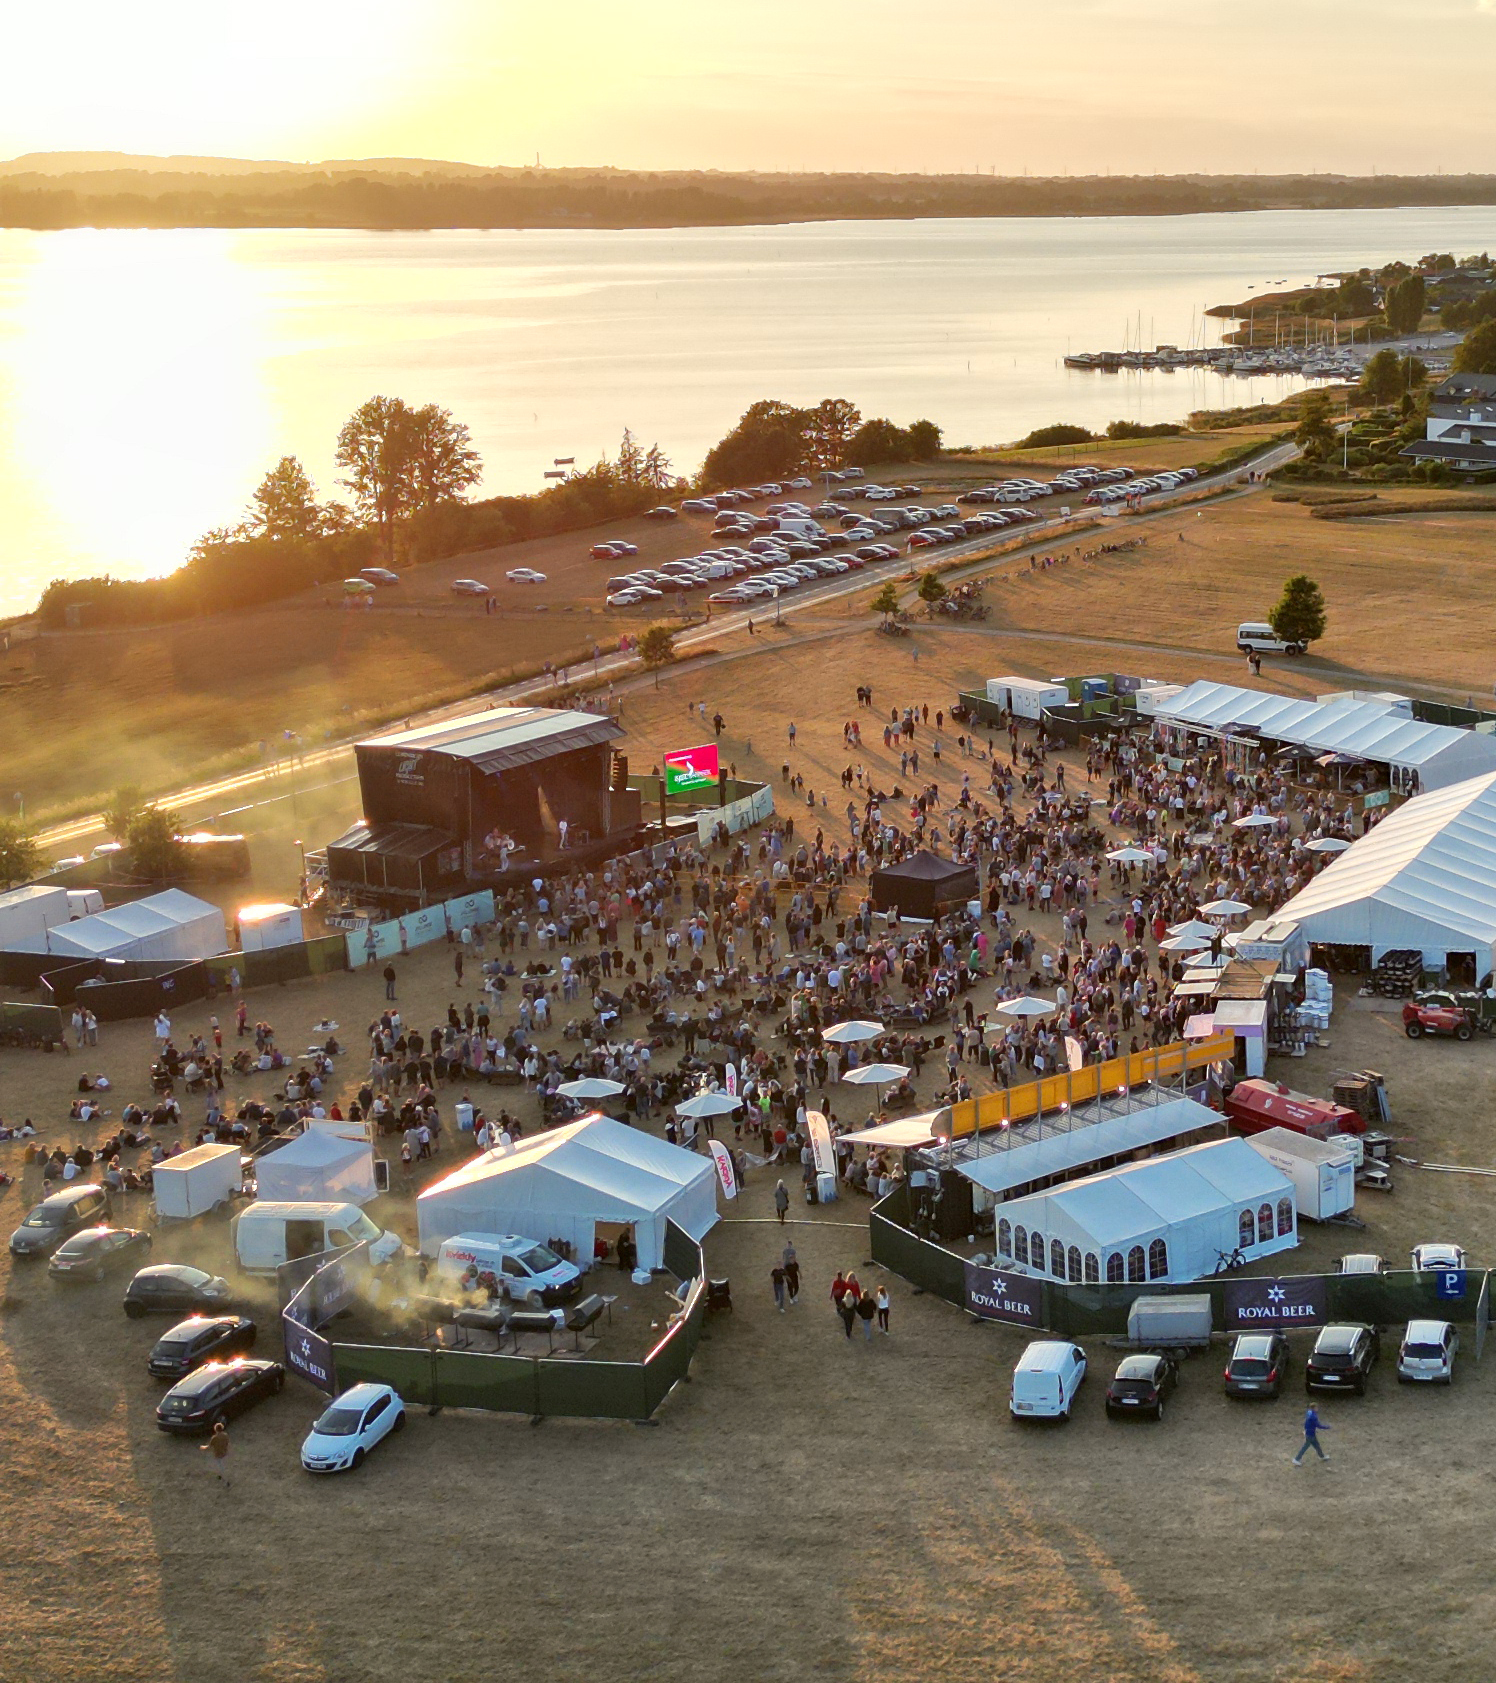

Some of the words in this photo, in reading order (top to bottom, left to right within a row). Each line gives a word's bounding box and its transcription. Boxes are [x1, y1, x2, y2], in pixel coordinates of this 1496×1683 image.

[1445, 1273, 1458, 1289] P
[970, 1290, 1002, 1309] ROYAL
[1004, 1300, 1032, 1315] BEER
[1238, 1306, 1279, 1319] ROYAL
[1282, 1304, 1316, 1317] BEER
[290, 1350, 309, 1372] ROYAL
[309, 1362, 327, 1381] BEER
